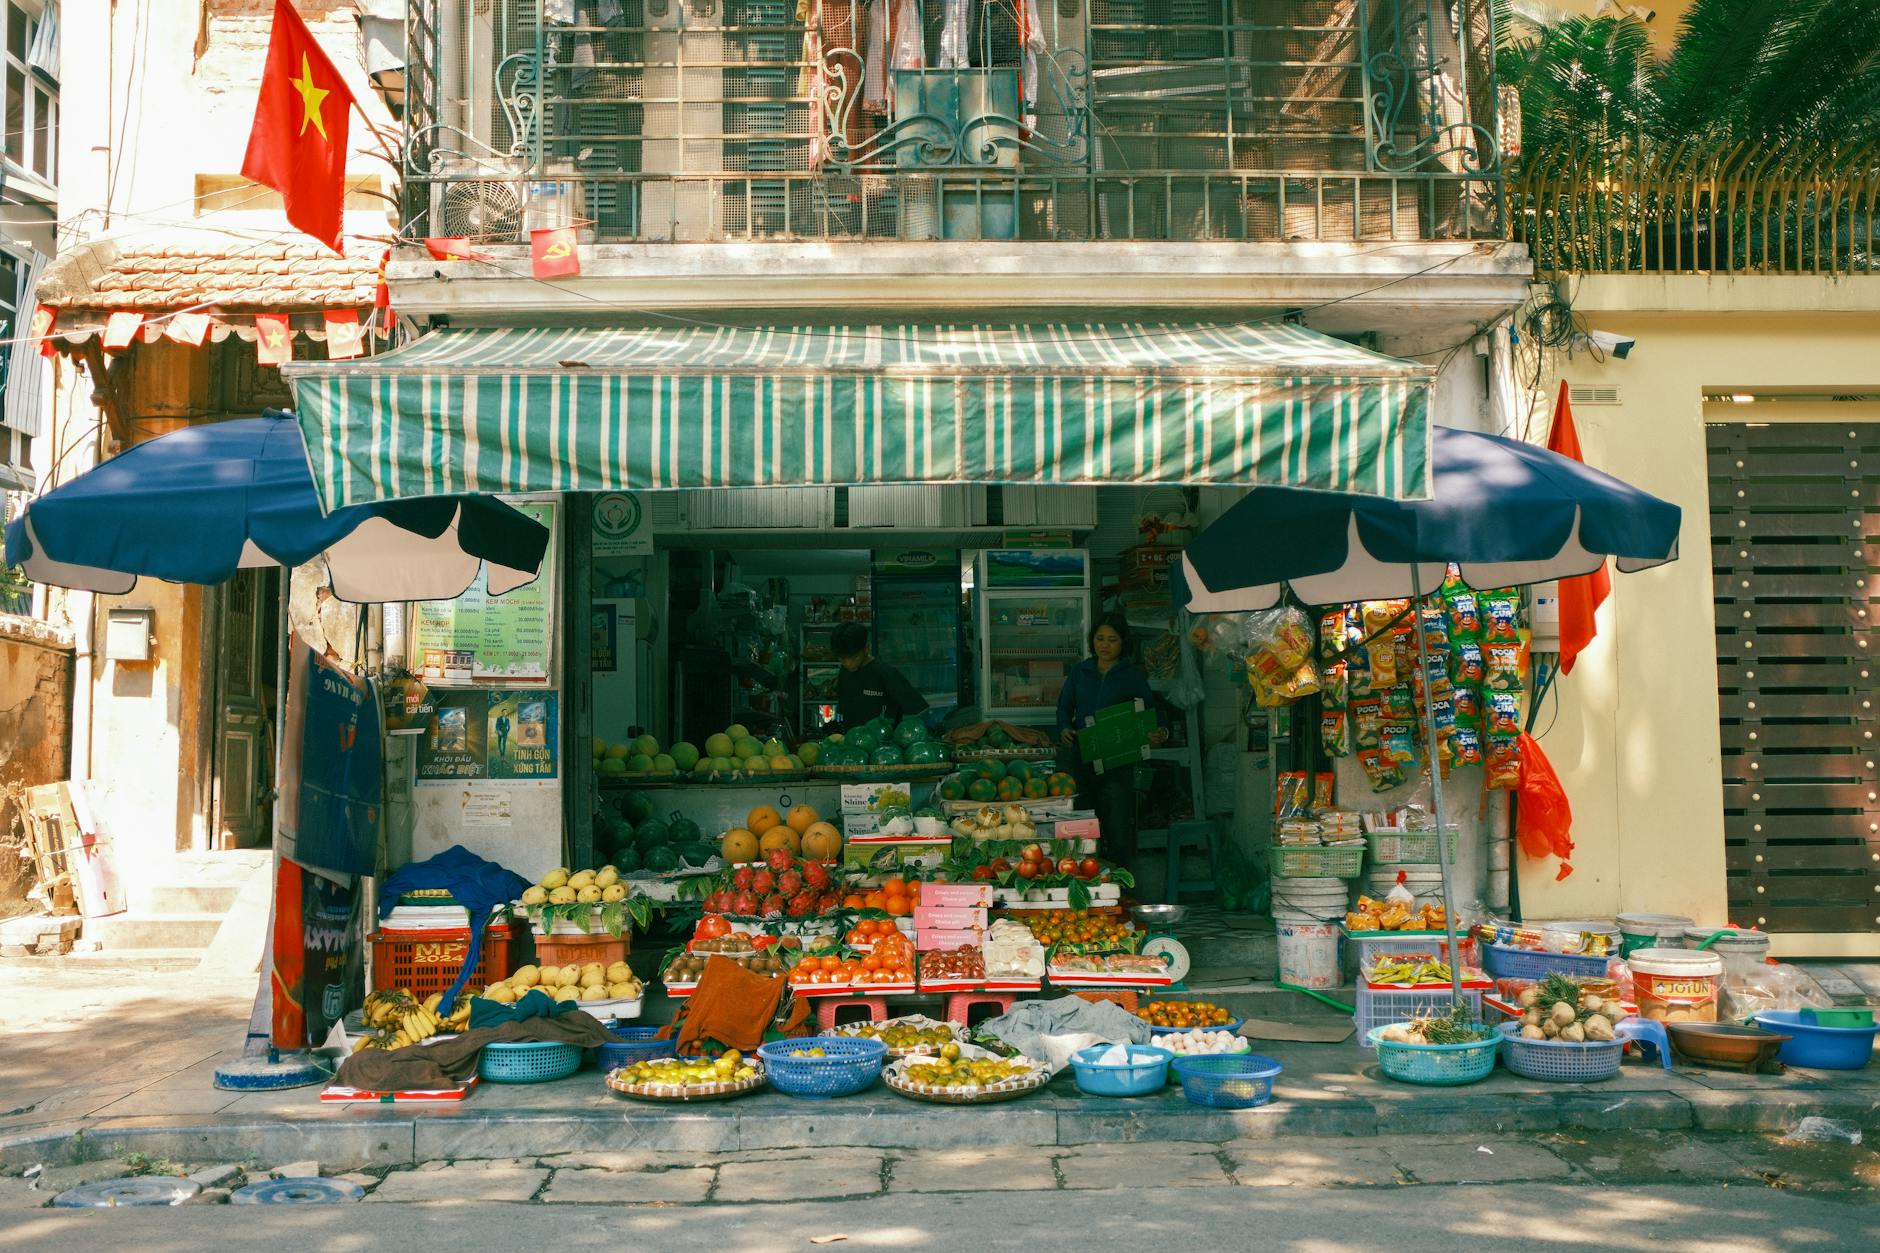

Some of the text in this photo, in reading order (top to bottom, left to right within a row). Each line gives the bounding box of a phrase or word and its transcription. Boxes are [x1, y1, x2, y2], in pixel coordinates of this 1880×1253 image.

[1457, 604, 1475, 612] CUA
[1493, 610, 1512, 618] CUA
[1463, 652, 1482, 661] CUA
[1491, 648, 1515, 656] POCA
[419, 703, 433, 713] tiến
[1495, 704, 1515, 713] CUA
[1383, 726, 1408, 735] POCA
[1460, 737, 1478, 745] CUA
[416, 943, 463, 956] MP
[414, 954, 464, 962] 2024
[1668, 982, 1709, 993] JOTUN
